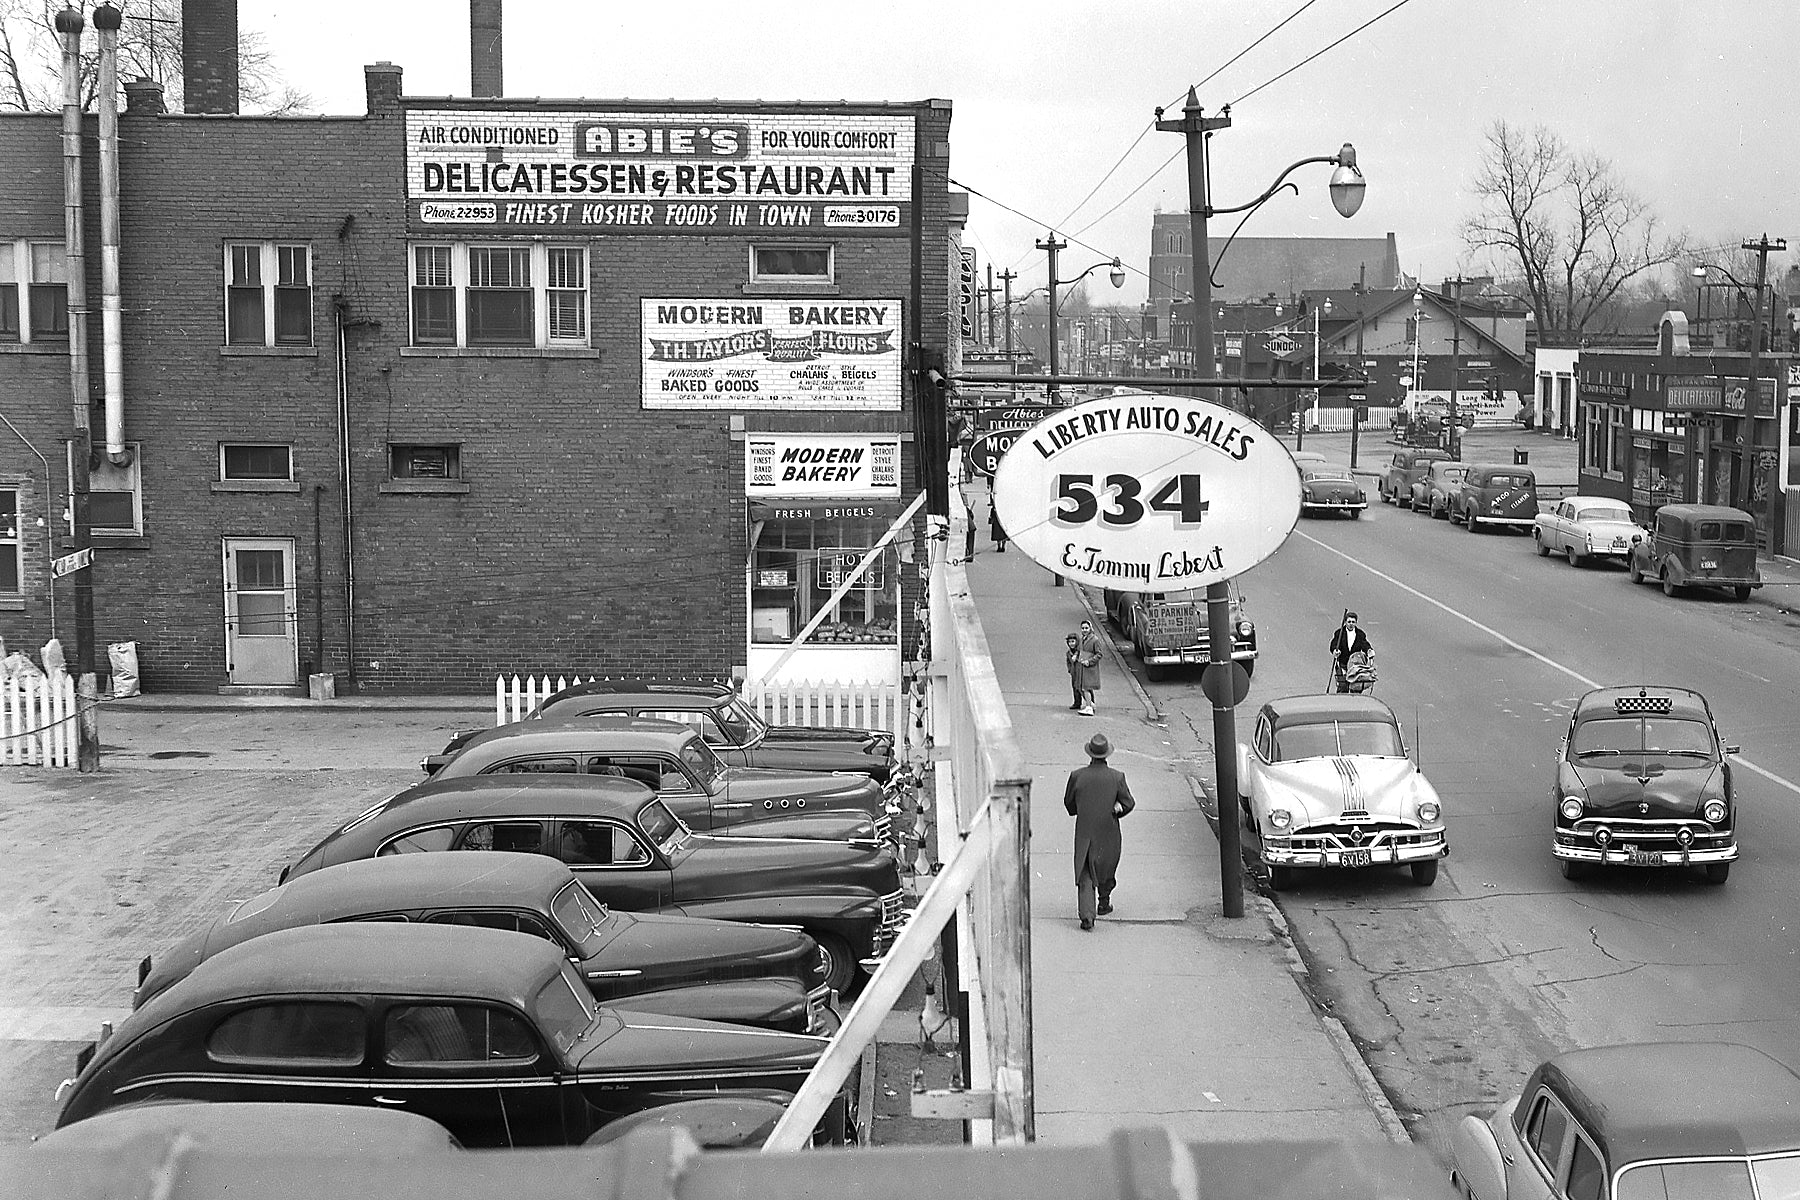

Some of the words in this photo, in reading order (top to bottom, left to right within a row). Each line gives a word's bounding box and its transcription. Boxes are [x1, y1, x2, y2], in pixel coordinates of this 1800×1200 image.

[420, 126, 446, 144] AIR
[450, 126, 559, 145] CONDITIONED
[585, 126, 739, 155] ABIE'S
[761, 130, 788, 149] FOR
[792, 130, 830, 149] YOUR
[834, 132, 897, 149] COMFORT
[423, 162, 645, 193] DELICATESSEN
[676, 165, 895, 196] RESTAURANT
[504, 203, 572, 225] FINEST
[581, 203, 654, 225] KOSHER
[664, 204, 719, 226] FOODS
[729, 205, 749, 226] IN
[758, 205, 812, 227] TOWN
[657, 305, 763, 325] MODERN
[788, 306, 888, 326] BAKERY
[819, 331, 878, 352] FLOURS
[1265, 341, 1301, 351] SUNOCO
[725, 369, 758, 378] FINEST
[841, 370, 877, 380] BEIGELS
[661, 379, 707, 392] BAKED
[714, 379, 759, 392] GOODS
[1668, 389, 1722, 406] DELICATESSEN
[989, 420, 1034, 430] DELICAT
[1670, 418, 1716, 427] LUNCH
[1032, 408, 1121, 460] LIBERTY
[1126, 406, 1180, 431] AUTO
[1183, 410, 1255, 462] SALES
[780, 447, 865, 464] MODERN
[872, 447, 895, 455] DETROIT
[753, 456, 771, 464] FINEST
[874, 456, 892, 464] STYLE
[781, 466, 862, 482] BAKERY
[1054, 473, 1210, 527] 534
[774, 509, 811, 519] FRESH
[825, 507, 874, 518] BEIGELS
[1155, 545, 1224, 580] Lebert
[1148, 608, 1159, 618] NO
[1161, 607, 1194, 618] PARKING
[1149, 618, 1157, 628] 3
[1176, 617, 1184, 626] 5
[1148, 627, 1163, 635] MON
[1184, 625, 1196, 634] FRI
[1341, 853, 1370, 867] 6V158
